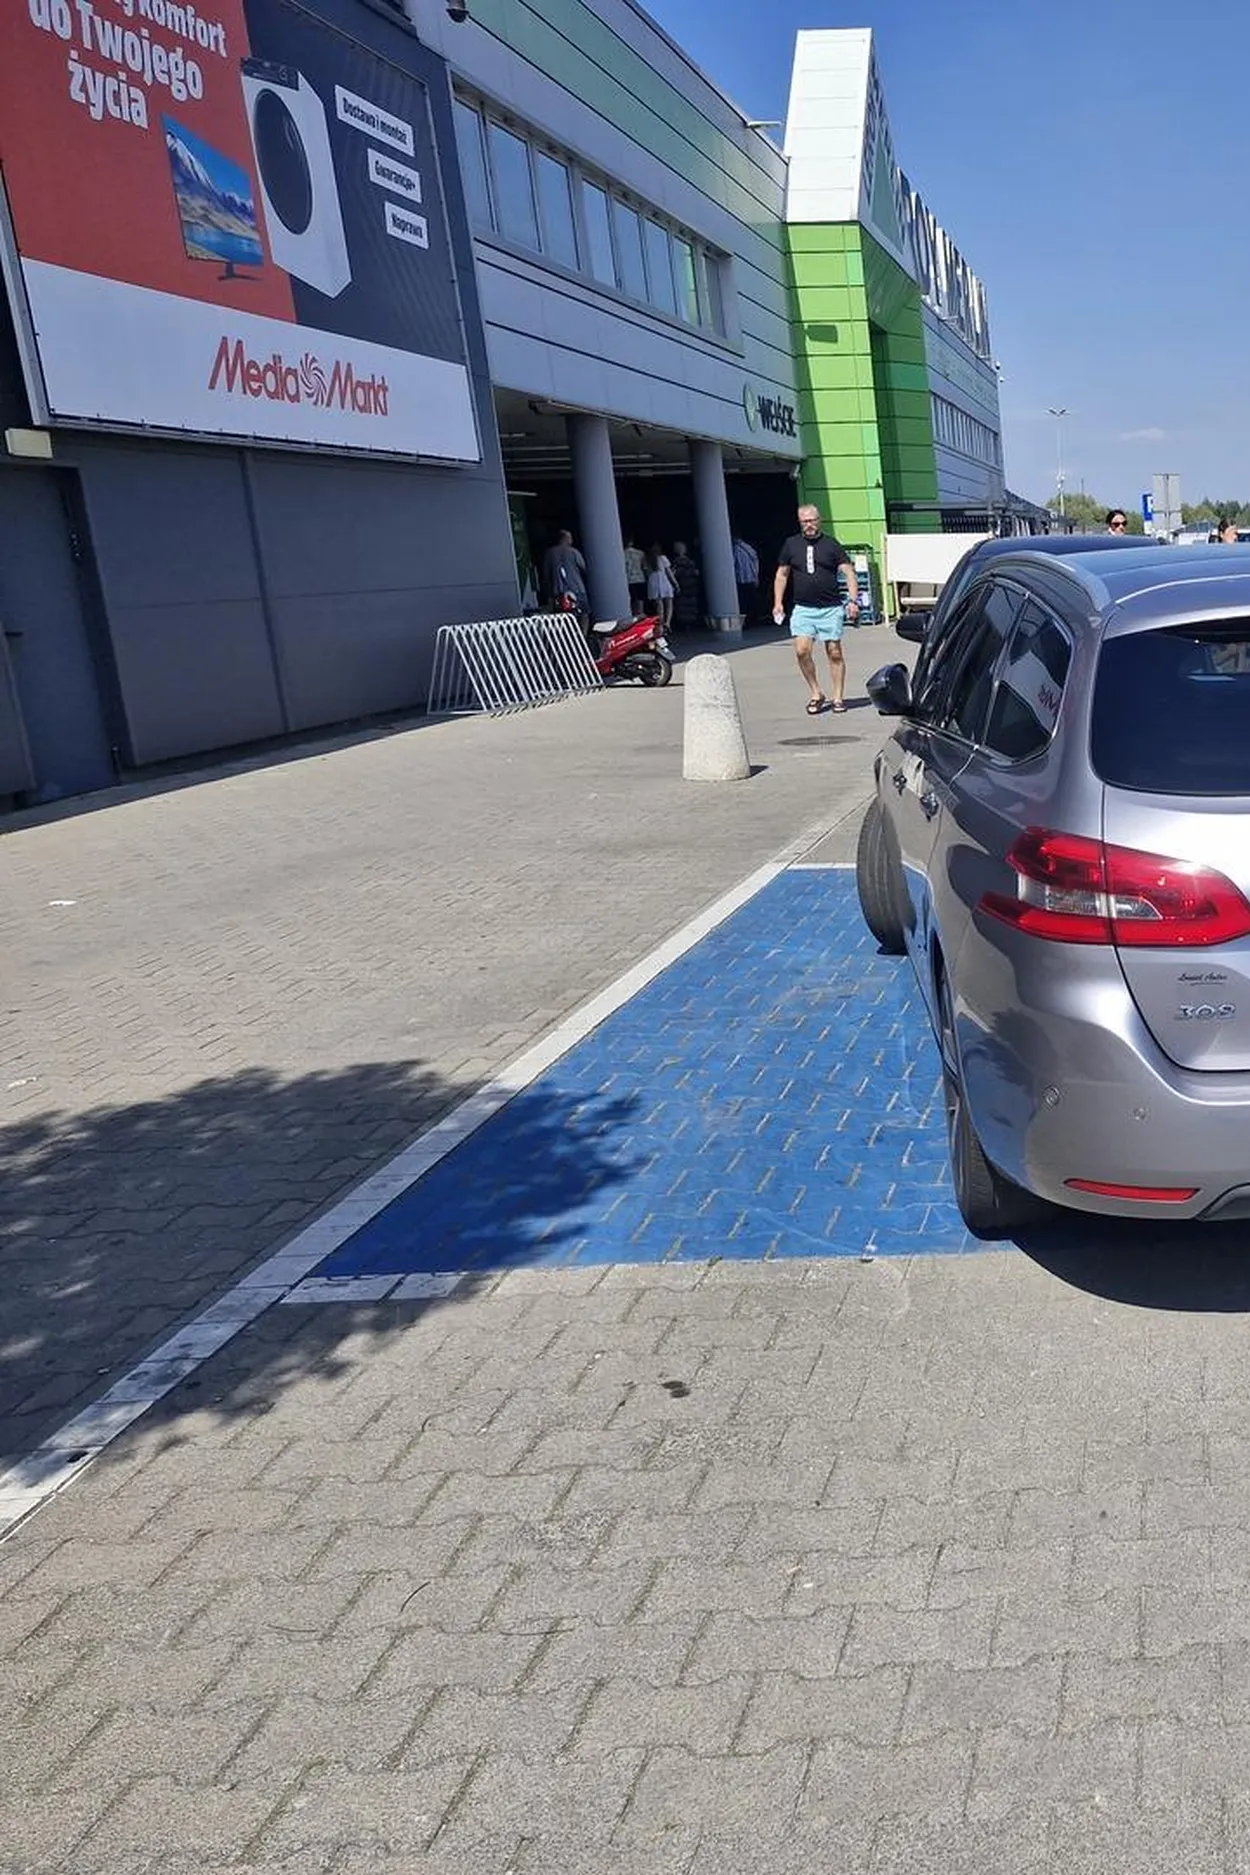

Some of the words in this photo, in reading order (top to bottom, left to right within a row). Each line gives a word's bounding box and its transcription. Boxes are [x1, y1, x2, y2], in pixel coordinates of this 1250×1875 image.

[67, 50, 148, 130] życia
[77, 0, 204, 101] Twojego
[343, 97, 376, 128] Dostawa
[391, 212, 424, 239] Naprawa
[208, 336, 300, 403] Media
[326, 360, 388, 417] Markt
